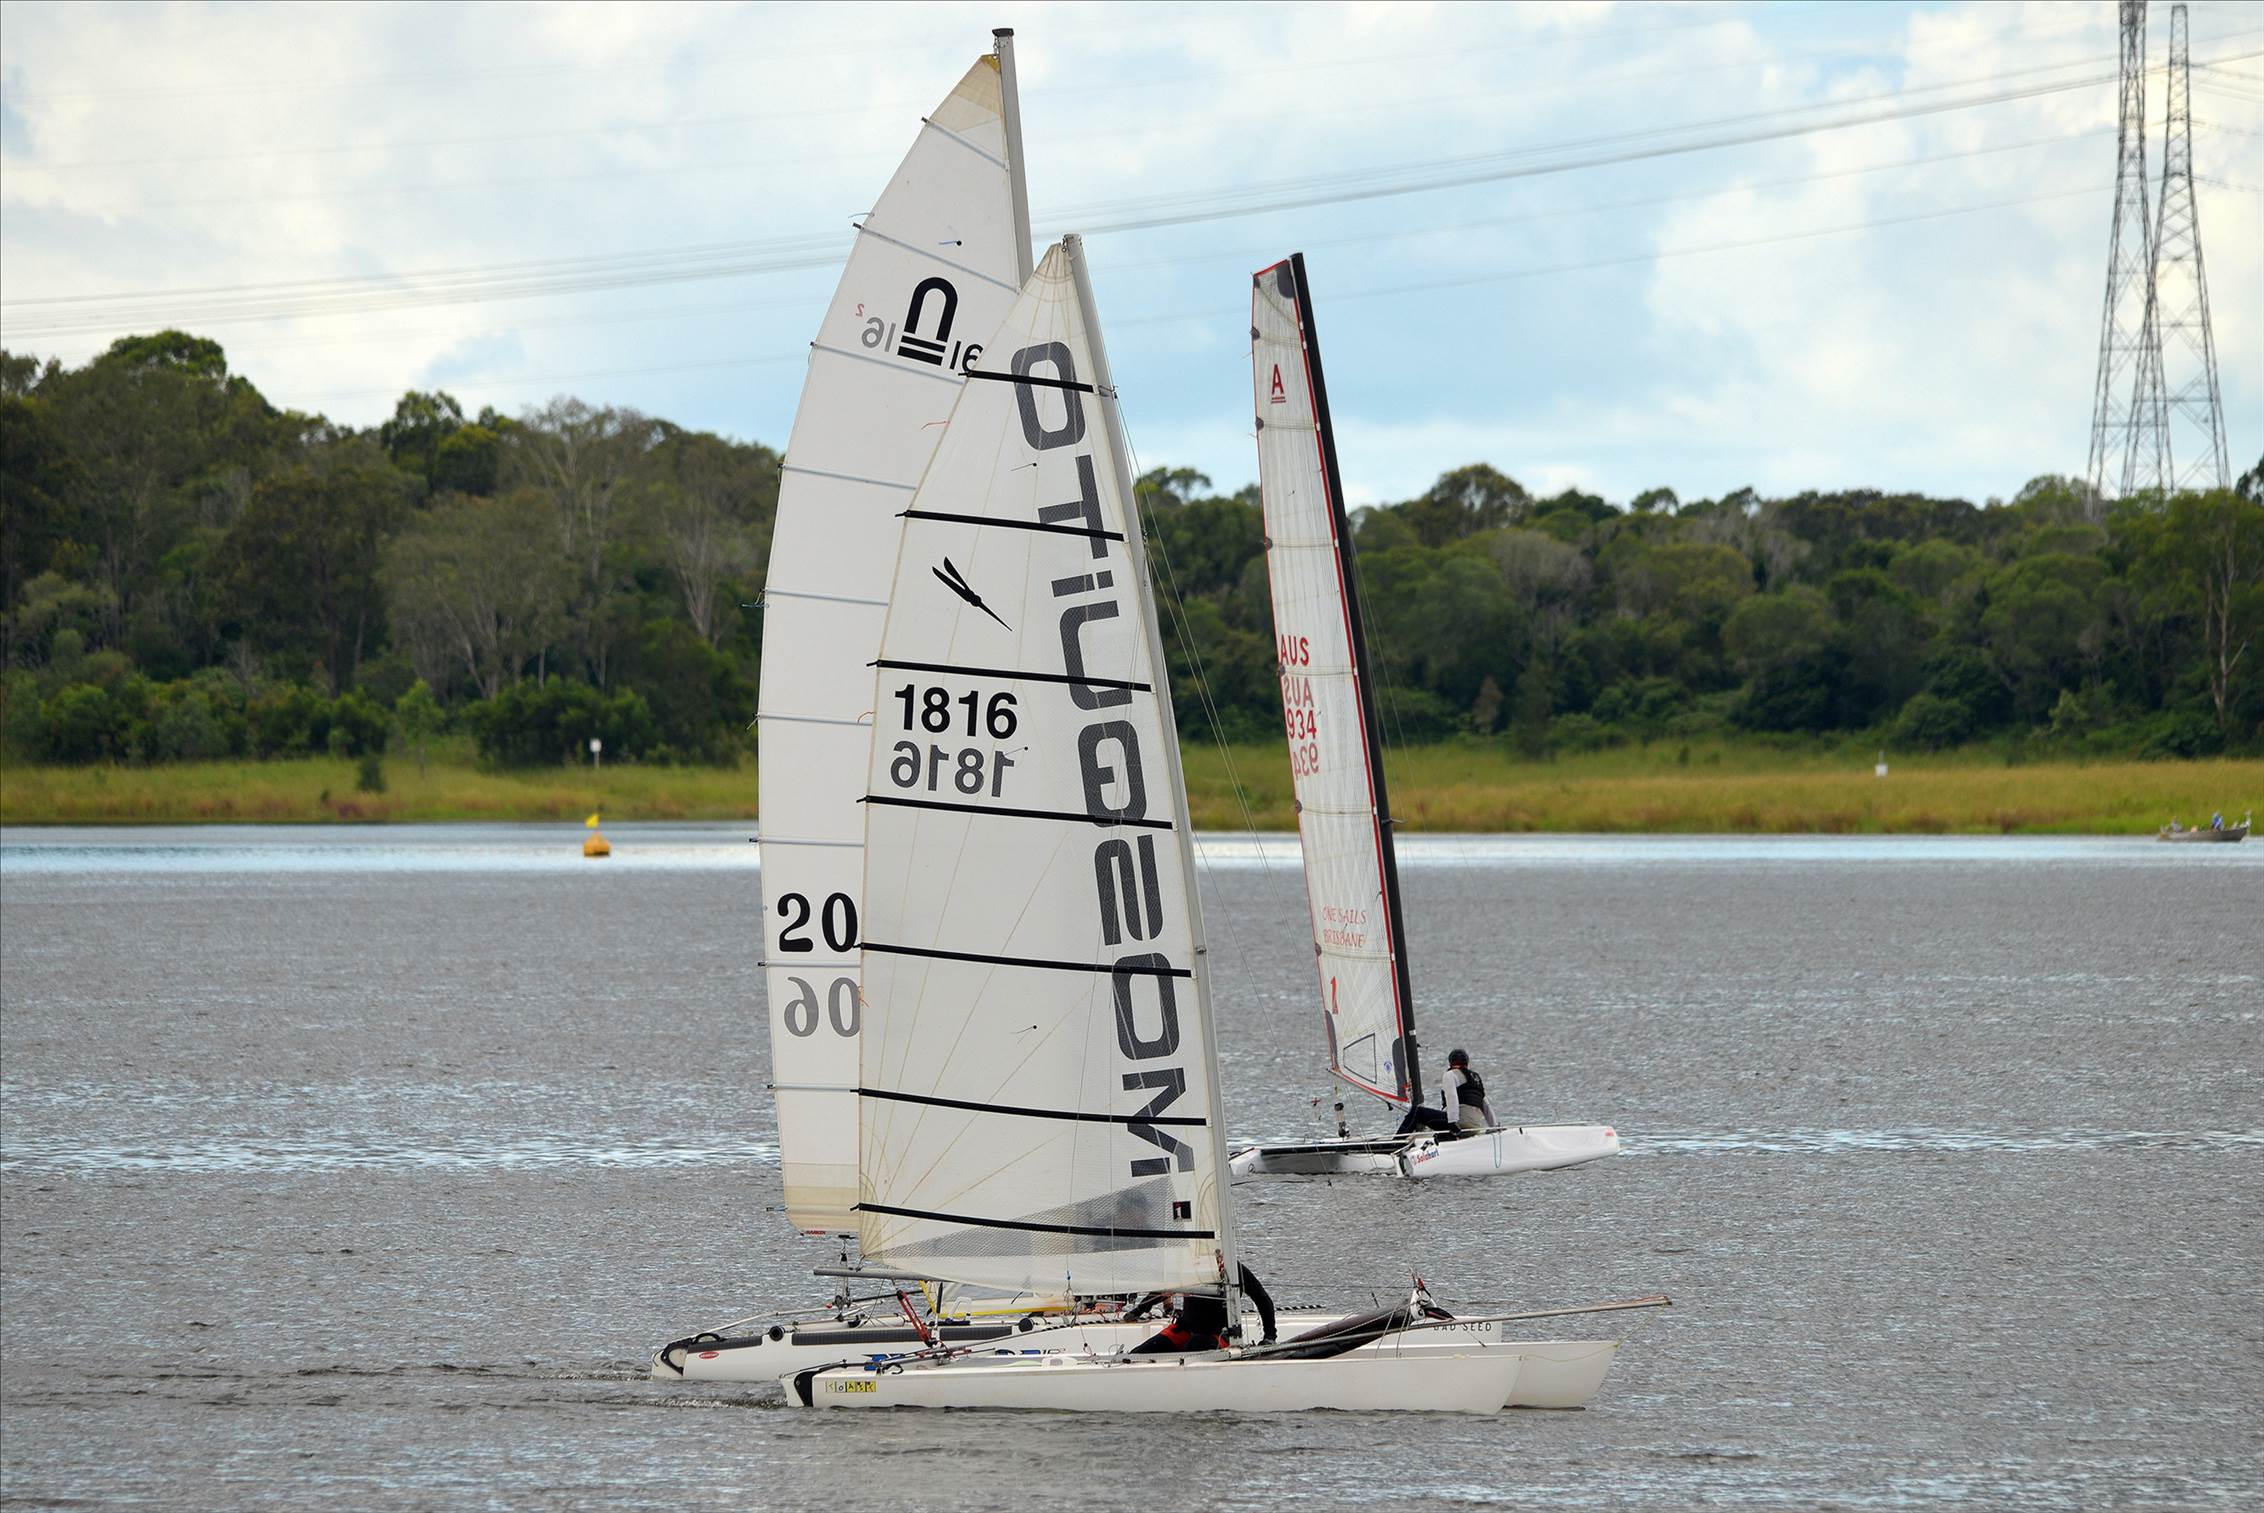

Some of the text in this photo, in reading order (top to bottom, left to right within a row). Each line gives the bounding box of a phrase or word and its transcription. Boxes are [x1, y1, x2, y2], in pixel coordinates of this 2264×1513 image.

[1271, 364, 1285, 395] A
[1281, 634, 1309, 666] AUS
[894, 684, 1018, 739] 1816
[1287, 708, 1317, 740] 934
[777, 892, 858, 953] 20
[1338, 908, 1367, 924] SAILS
[1462, 1322, 1492, 1332] SEED
